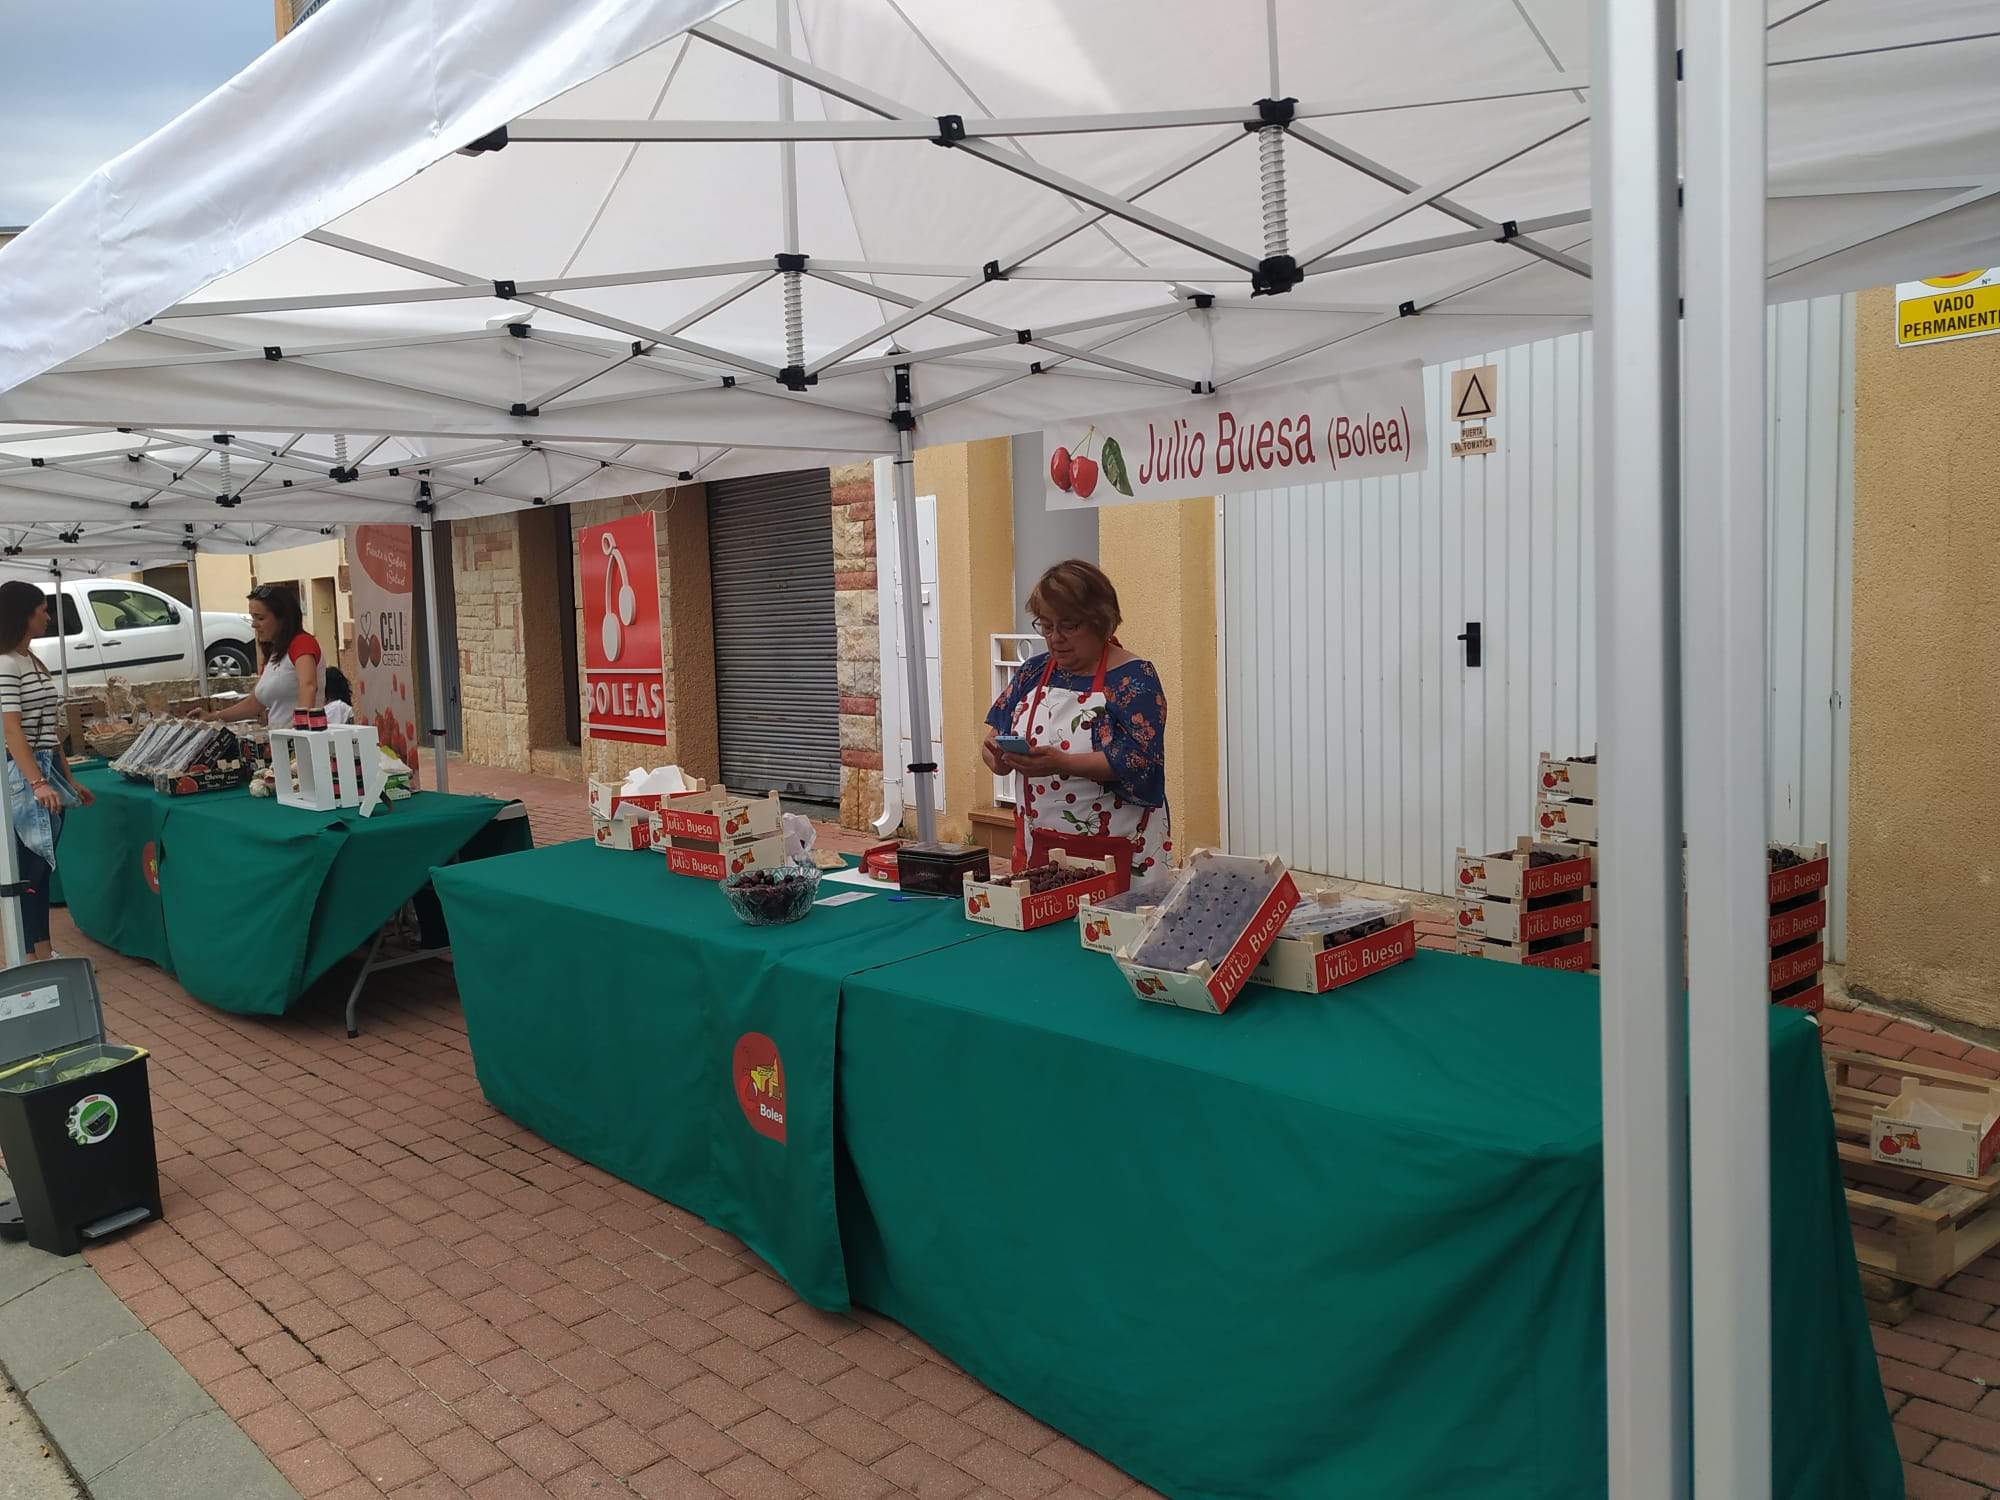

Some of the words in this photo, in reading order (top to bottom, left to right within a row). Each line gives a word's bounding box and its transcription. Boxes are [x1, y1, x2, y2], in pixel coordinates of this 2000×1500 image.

[1933, 294, 1974, 314] VADO
[1904, 309, 2000, 338] PERMANENT
[1462, 427, 1483, 438] PUERTA
[1139, 419, 1204, 486] Julio
[1214, 410, 1316, 475] Buesa
[1327, 406, 1411, 471] (Bolea)
[380, 611, 403, 651] CELI
[586, 681, 663, 720] BOLEAS
[666, 814, 685, 832] Julio
[687, 816, 713, 835] Buesa
[671, 853, 691, 870] Julio
[691, 857, 719, 875] Buesa
[1527, 876, 1551, 896] Julio
[1553, 870, 1582, 886] Buesa
[1770, 879, 1791, 900] Julio
[1794, 871, 1821, 890] Buesa
[1029, 900, 1063, 926] Julio
[1067, 888, 1106, 911] Busa
[1526, 918, 1550, 939] Julio
[1553, 913, 1582, 930] Buesa
[1792, 914, 1819, 933] Buesa
[1218, 951, 1250, 1003] Julio
[1249, 899, 1288, 954] Buesa
[1323, 950, 1348, 961] Cerezas
[1324, 956, 1357, 988] Julio
[1361, 940, 1403, 968] Buesa
[1792, 956, 1818, 976] Buesa
[760, 1103, 783, 1124] Bolea
